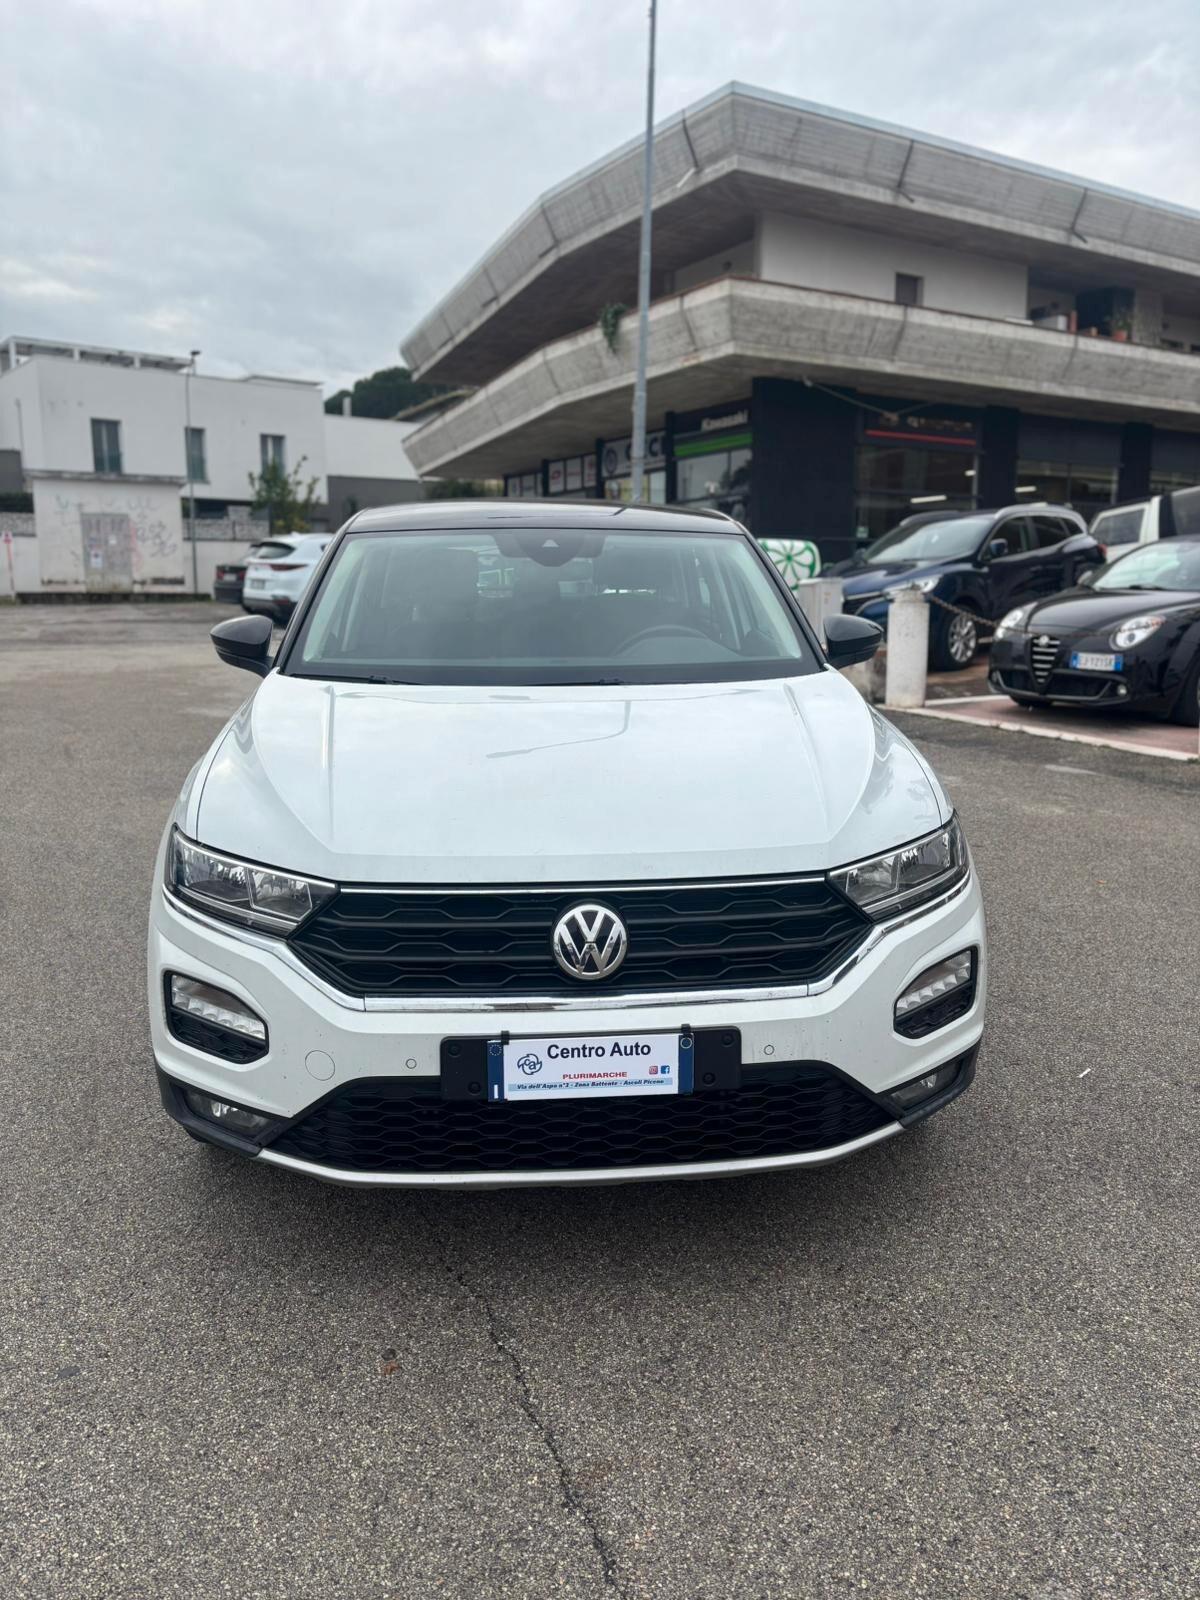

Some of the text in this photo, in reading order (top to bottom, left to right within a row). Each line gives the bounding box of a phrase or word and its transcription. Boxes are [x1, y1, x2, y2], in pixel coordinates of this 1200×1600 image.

[547, 1041, 651, 1059] Centro Auto
[562, 1071, 628, 1080] PLURIMARCHE
